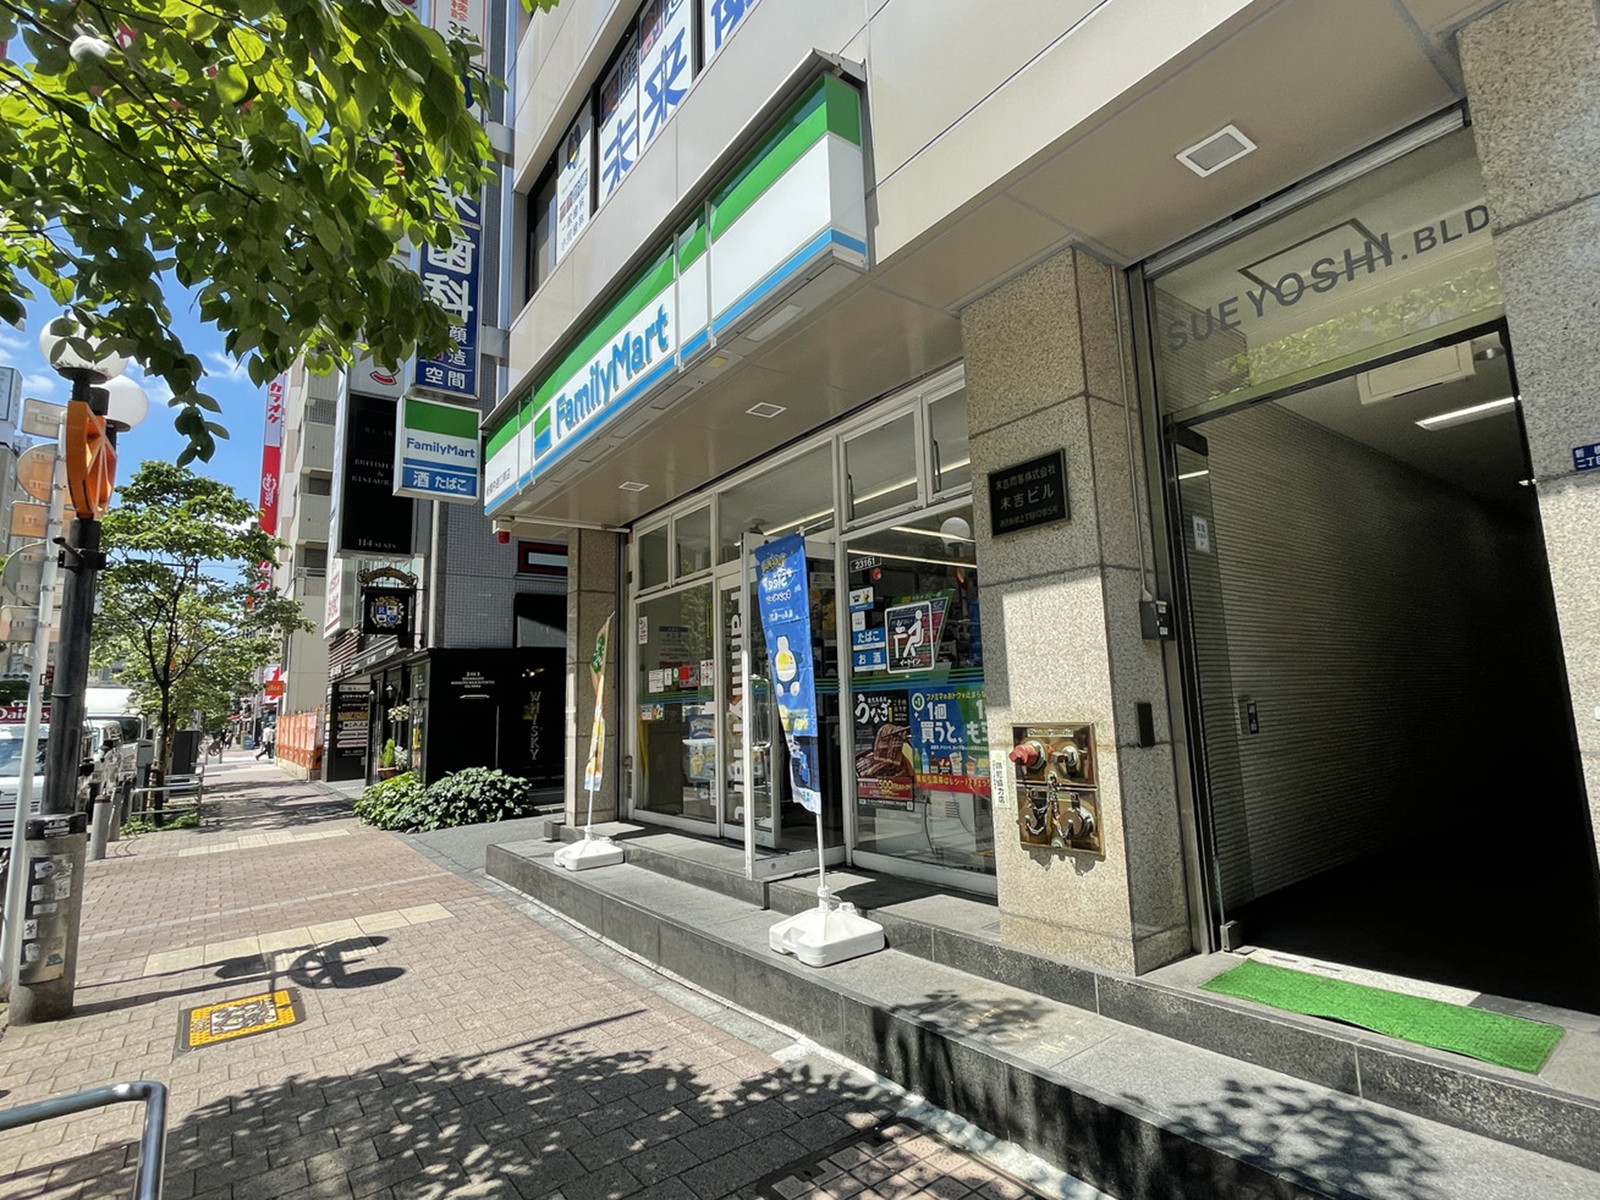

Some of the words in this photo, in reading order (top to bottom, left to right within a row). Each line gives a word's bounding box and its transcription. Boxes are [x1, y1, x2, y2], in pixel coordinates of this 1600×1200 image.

[425, 366, 466, 390] 空間
[556, 302, 670, 439] FamilyMart
[267, 381, 283, 424] カラオケ
[406, 437, 476, 459] FamilyMart
[413, 471, 430, 488] 酒
[435, 475, 467, 491] たばこ
[854, 557, 876, 570] 23161
[857, 630, 881, 644] たばこ
[855, 693, 892, 724] うなぎ
[529, 691, 542, 761] WHISKY
